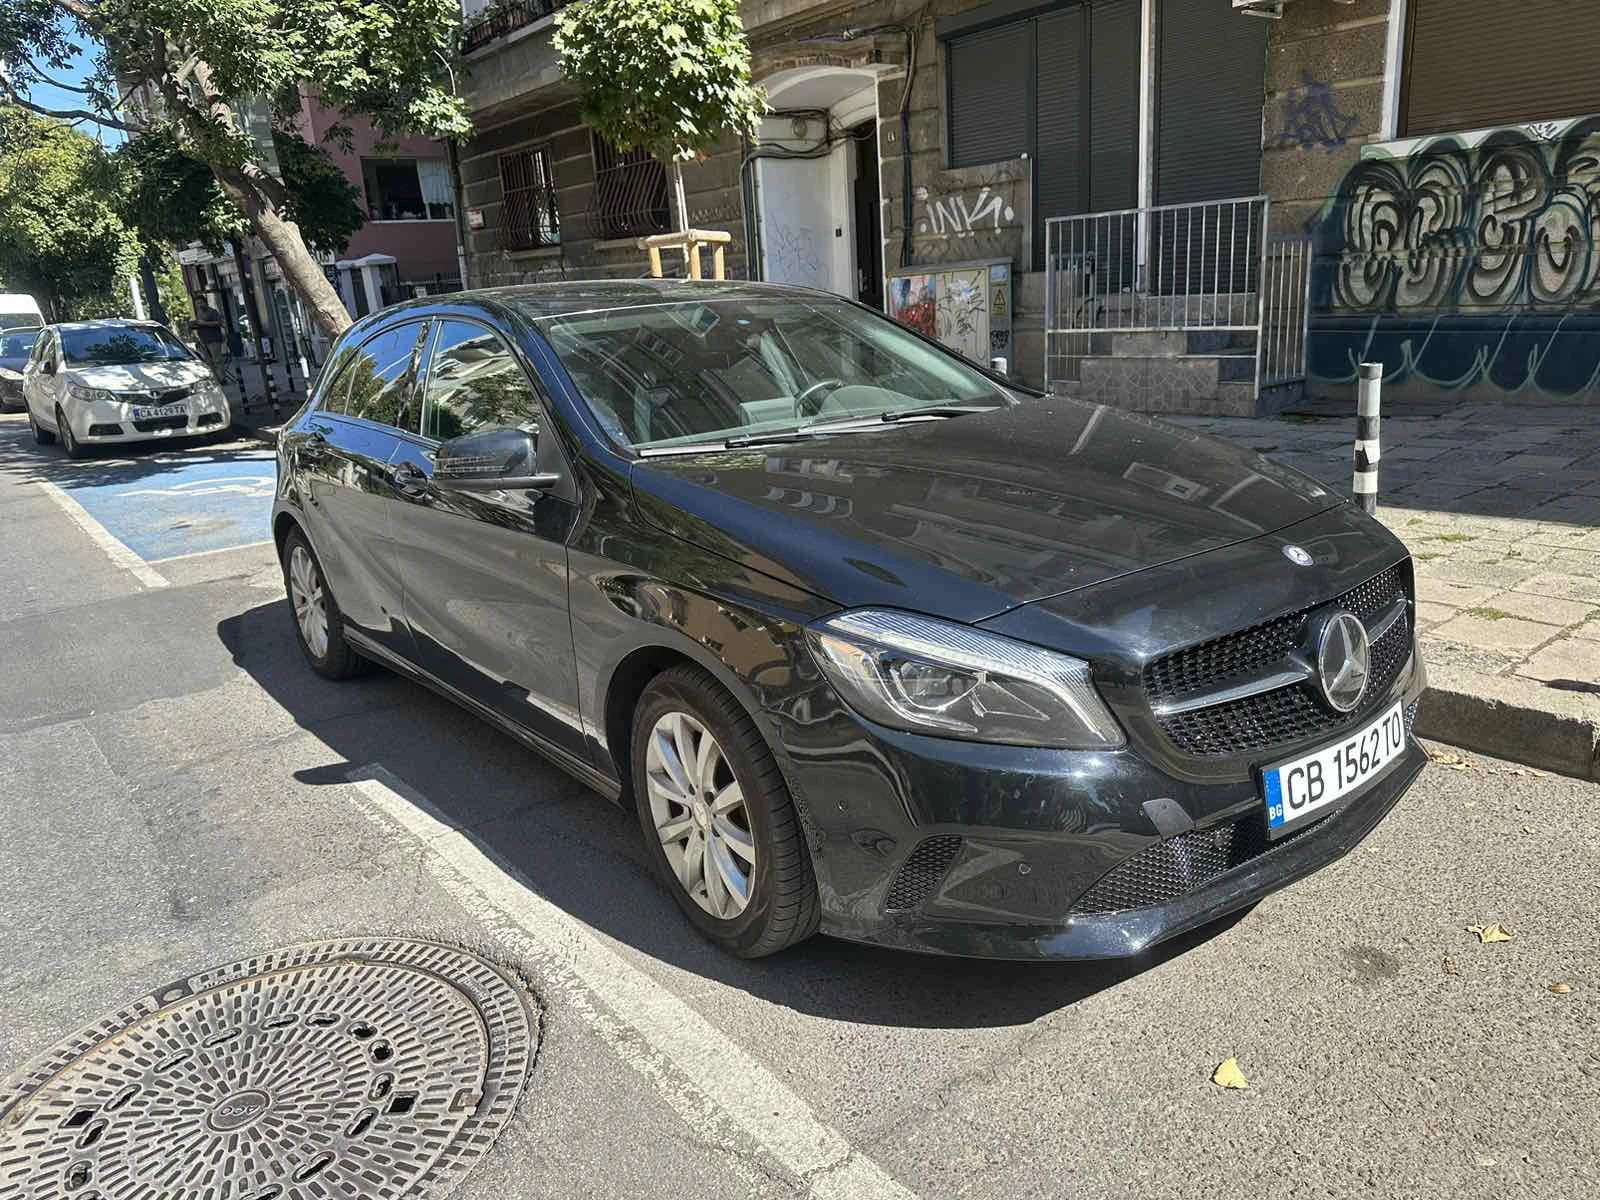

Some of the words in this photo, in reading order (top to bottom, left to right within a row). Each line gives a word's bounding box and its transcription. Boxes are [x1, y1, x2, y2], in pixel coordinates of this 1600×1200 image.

[1287, 760, 1325, 811] CB
[1334, 728, 1381, 790] 1562
[1382, 711, 1401, 757] TO
[1269, 805, 1283, 820] BG
[220, 1104, 261, 1116] ACO
